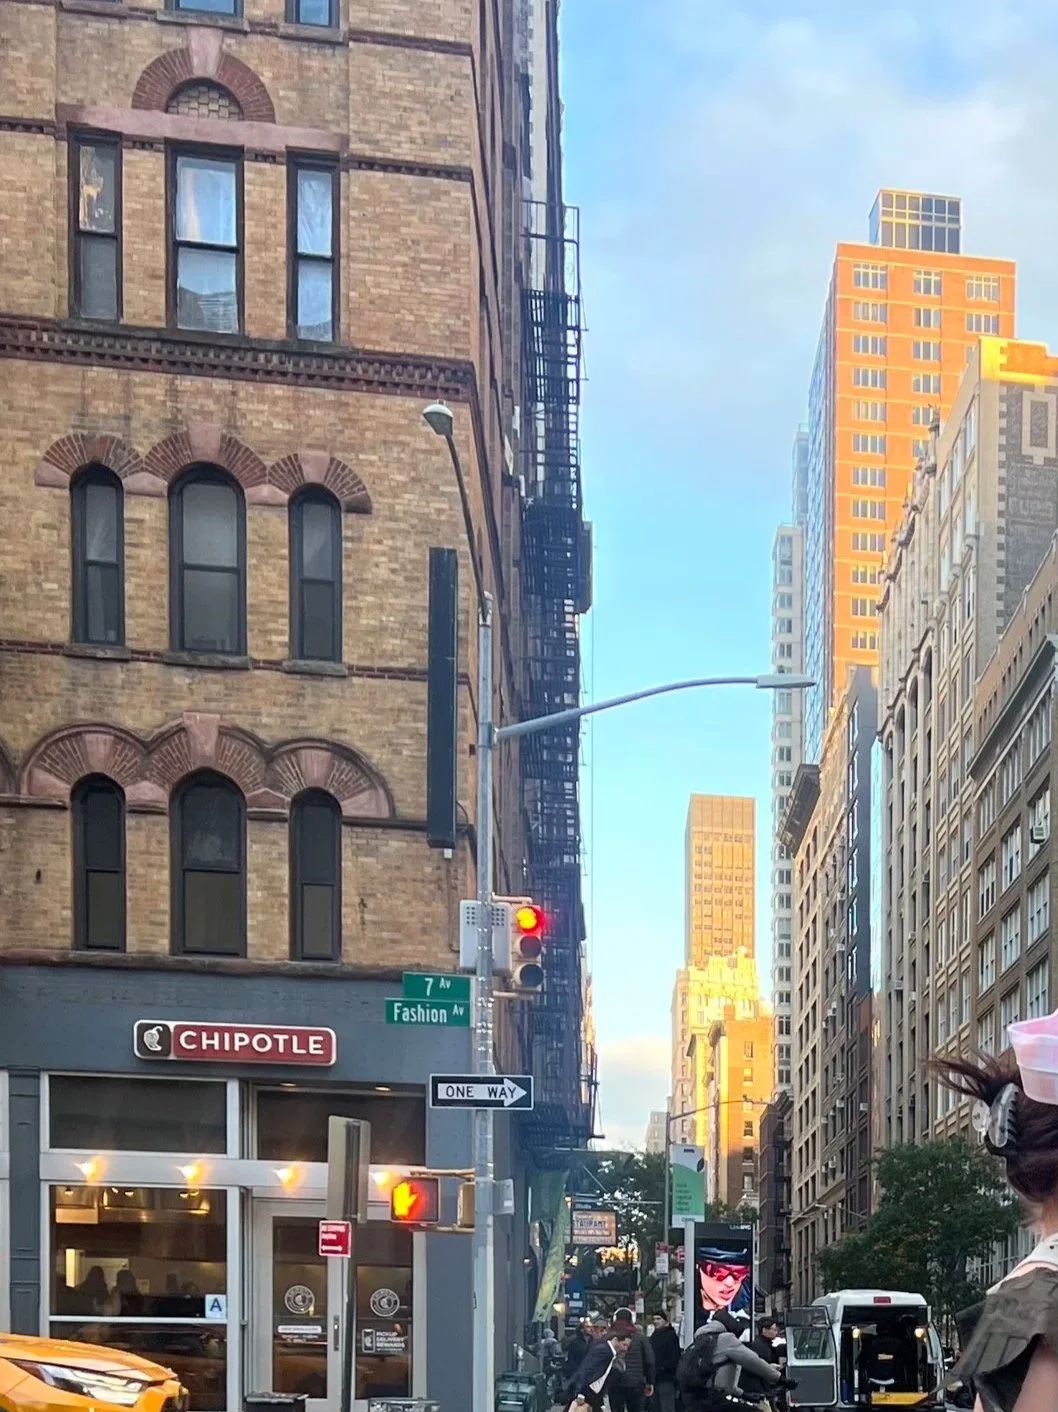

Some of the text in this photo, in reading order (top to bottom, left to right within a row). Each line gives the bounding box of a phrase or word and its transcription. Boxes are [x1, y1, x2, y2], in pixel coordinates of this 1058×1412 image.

[425, 977, 452, 997] 7 Av
[393, 1002, 465, 1023] Fashion Av
[179, 1030, 325, 1056] CHIPOTLE
[445, 1085, 517, 1099] ONE WAY
[210, 1297, 222, 1311] A
